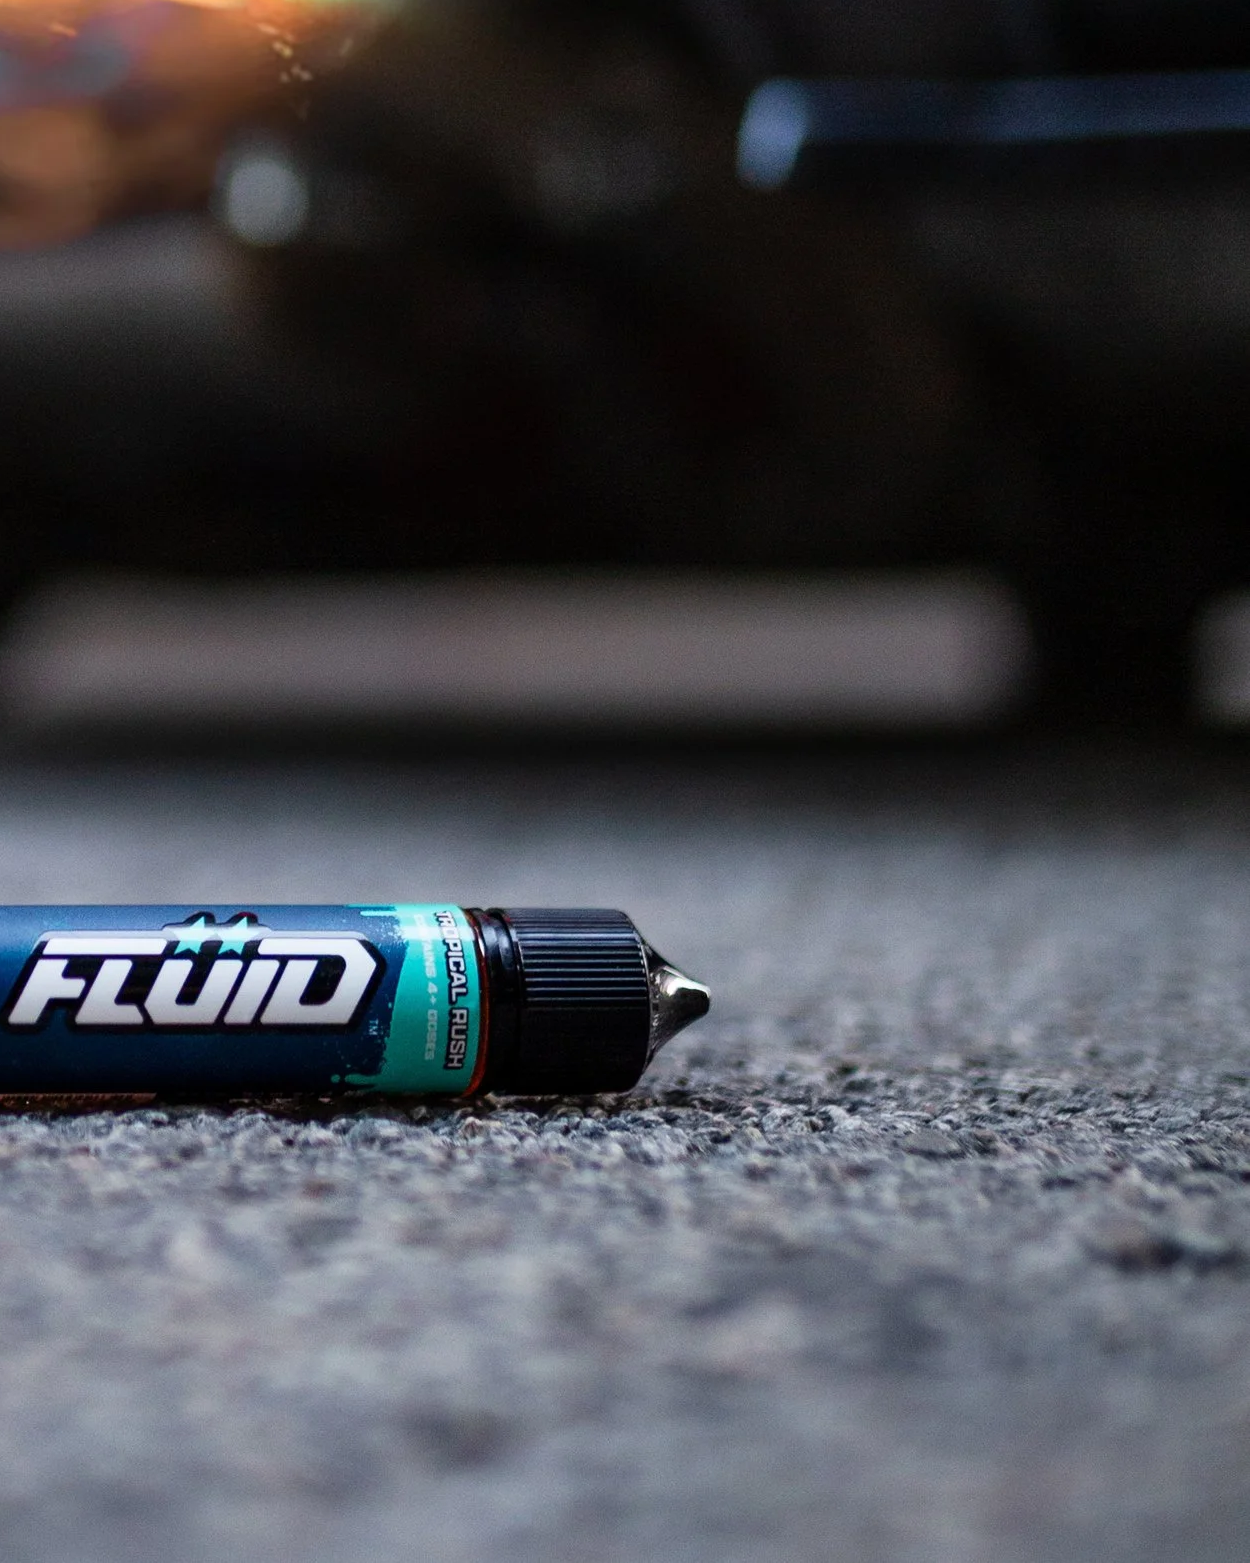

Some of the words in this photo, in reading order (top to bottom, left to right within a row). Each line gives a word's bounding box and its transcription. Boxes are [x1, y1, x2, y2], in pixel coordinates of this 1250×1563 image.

[435, 910, 467, 1002] TROPICAL
[427, 981, 438, 1005] 4+
[368, 1019, 379, 1036] TM
[425, 1009, 438, 1061] DOSES
[448, 1009, 468, 1068] RUSH
